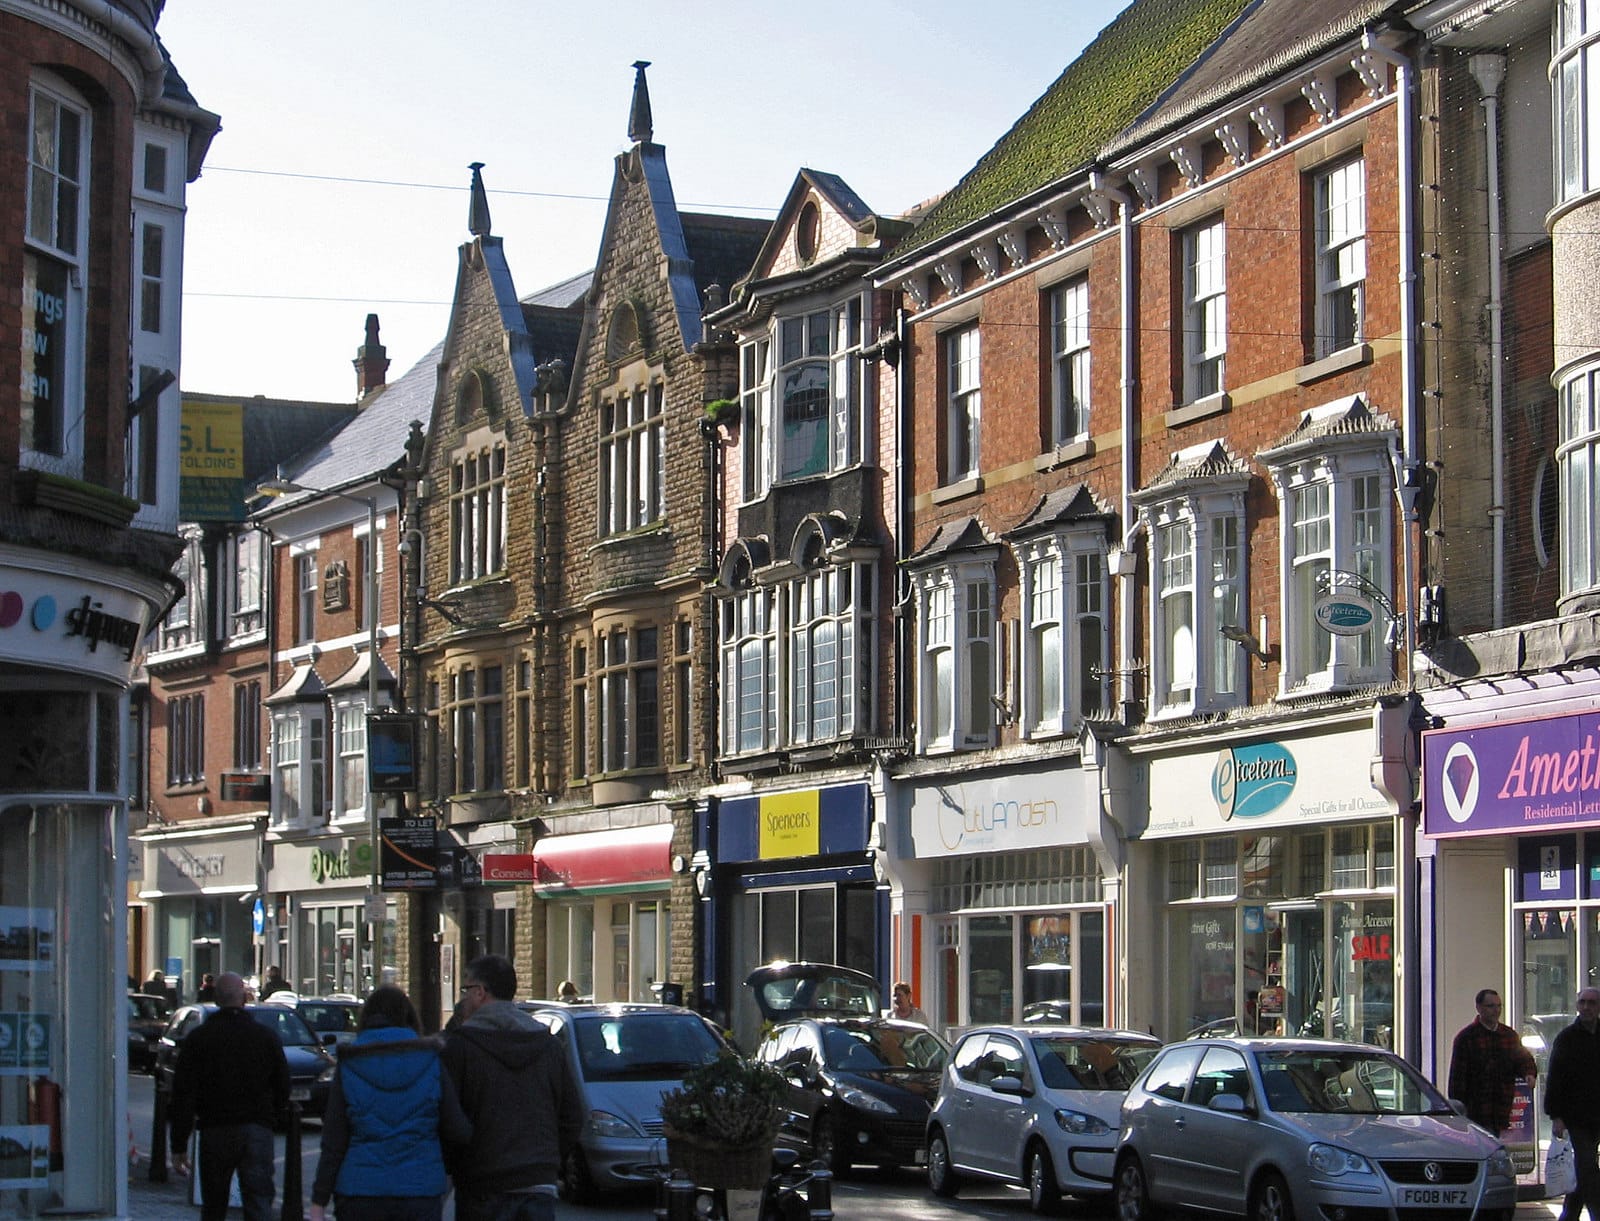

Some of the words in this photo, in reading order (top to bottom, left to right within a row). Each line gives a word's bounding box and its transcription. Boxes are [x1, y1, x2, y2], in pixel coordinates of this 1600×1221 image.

[1524, 802, 1577, 820] Residential
[404, 820, 416, 828] TO
[417, 819, 434, 828] LET
[766, 811, 811, 837] Spencers
[1352, 934, 1391, 960] SALE
[1404, 1190, 1440, 1203] FG08
[1443, 1191, 1467, 1204] NFZ
